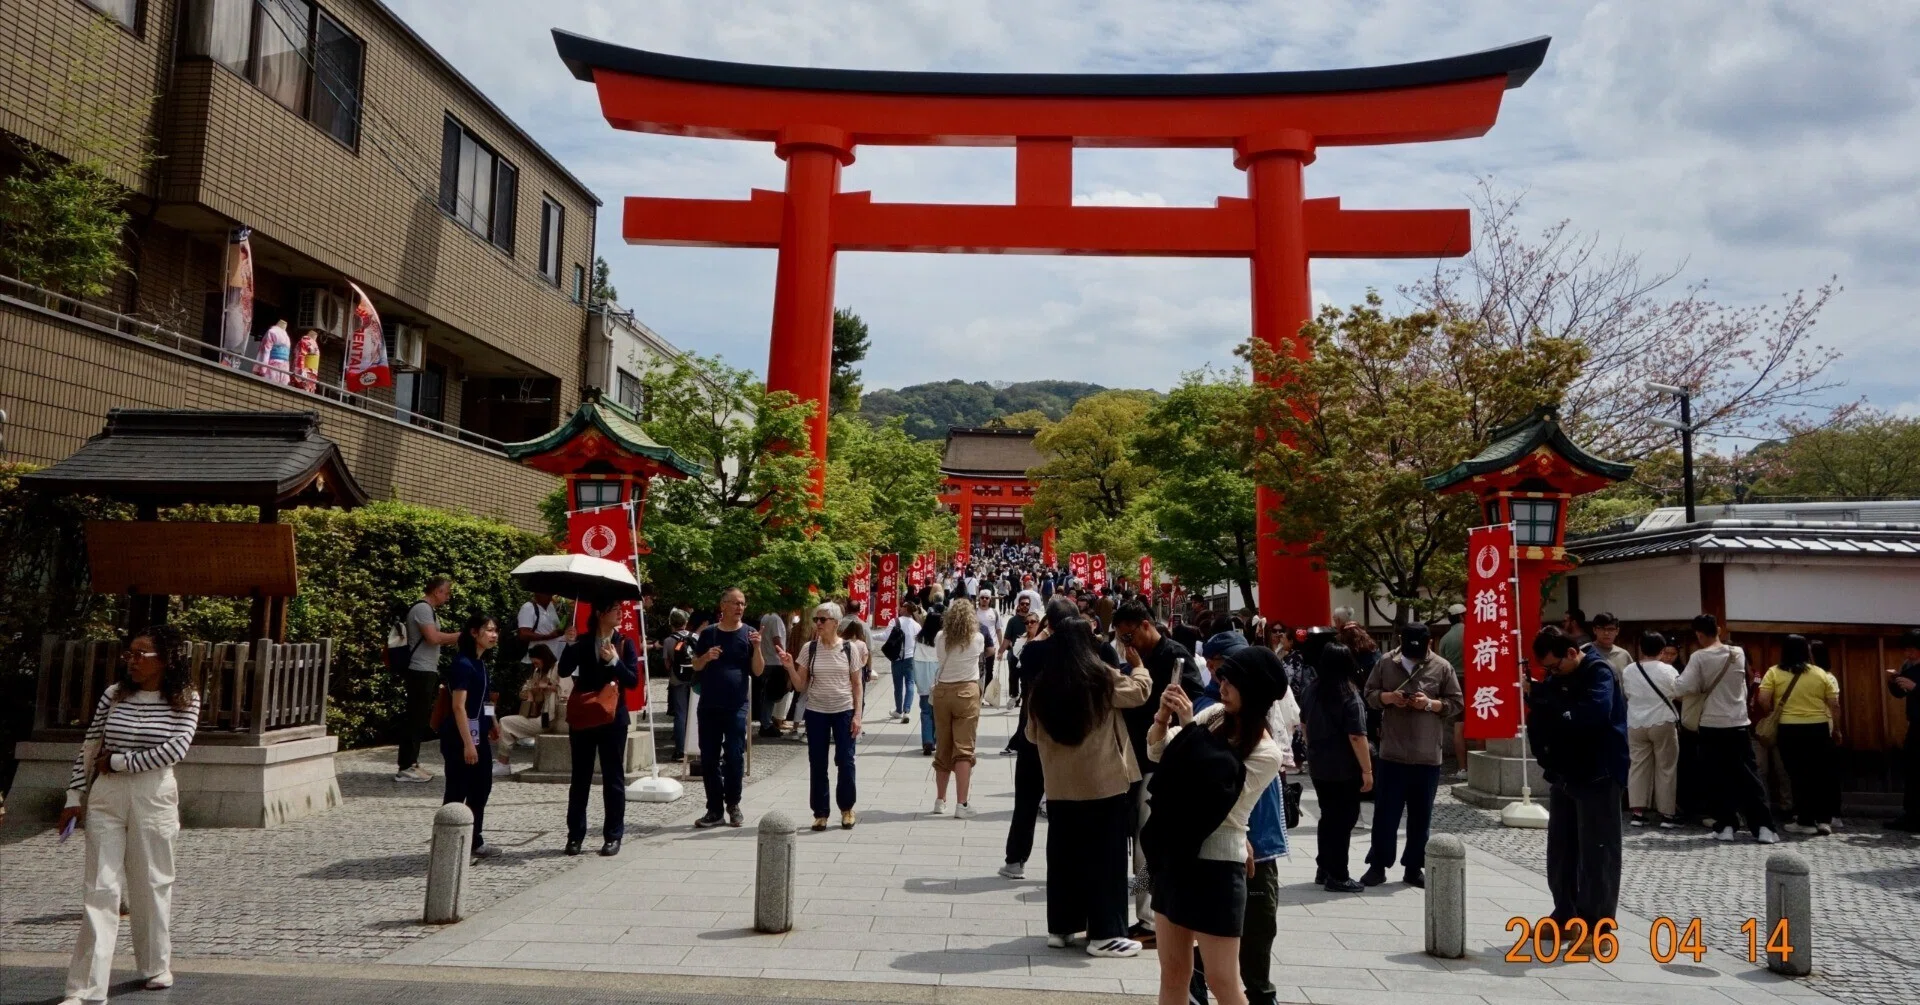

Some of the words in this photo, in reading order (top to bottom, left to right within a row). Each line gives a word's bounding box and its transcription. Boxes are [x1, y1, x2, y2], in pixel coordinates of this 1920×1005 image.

[880, 575, 893, 620] 稲荷祭
[1498, 581, 1510, 656] 伏見稲荷大社
[1470, 588, 1504, 720] 稲荷祭
